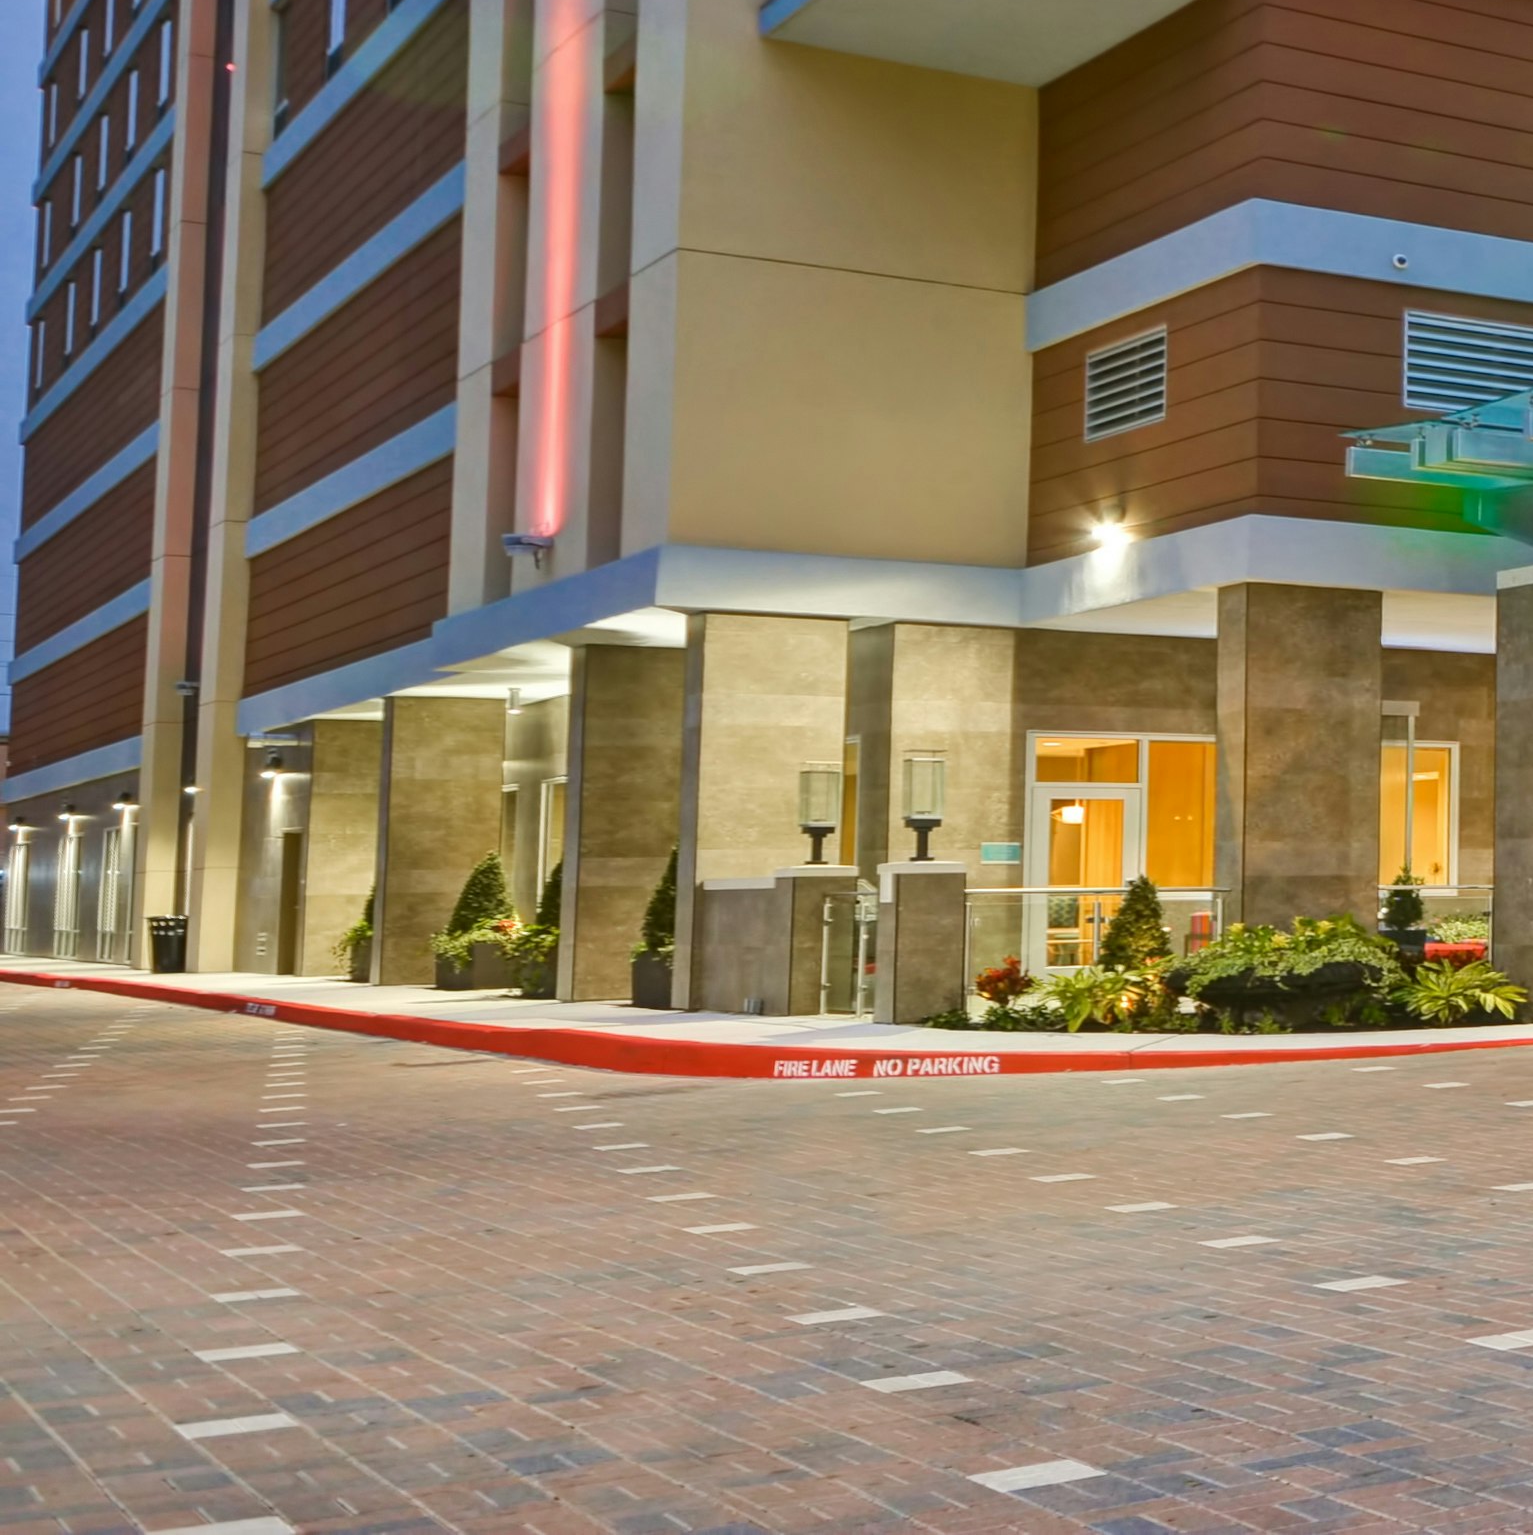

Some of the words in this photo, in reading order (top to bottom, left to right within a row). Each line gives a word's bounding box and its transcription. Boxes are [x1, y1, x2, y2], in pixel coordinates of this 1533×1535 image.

[773, 1060, 809, 1078] FIRE
[811, 1059, 858, 1078] LANE
[872, 1059, 903, 1078] NO
[906, 1055, 1001, 1077] PARKING
